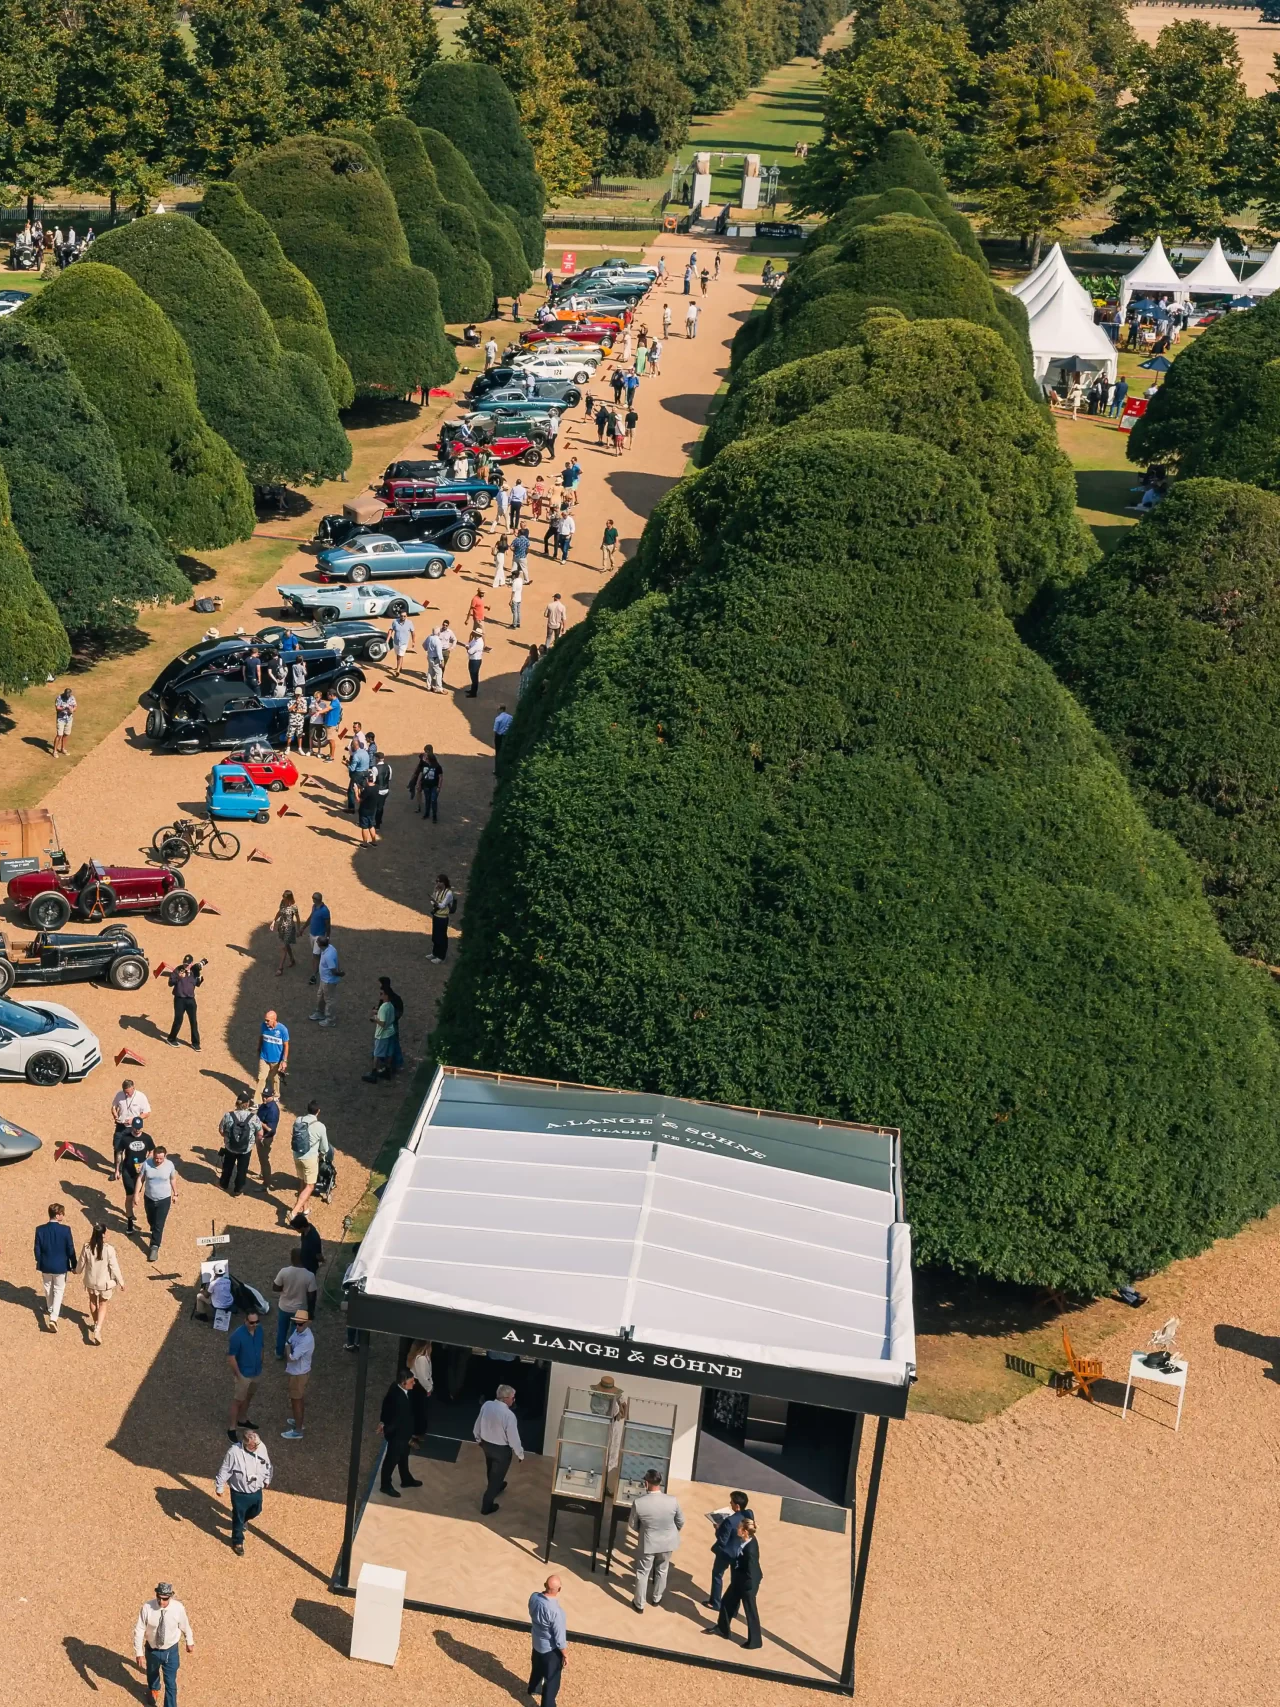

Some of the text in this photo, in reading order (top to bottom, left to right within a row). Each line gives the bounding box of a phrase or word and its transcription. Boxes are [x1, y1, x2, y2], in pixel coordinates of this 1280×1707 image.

[369, 602, 377, 614] 2
[661, 1120, 678, 1130] &
[684, 1126, 767, 1160] SÖHNE
[502, 1329, 743, 1379] A. LANGE & SÖHNE
